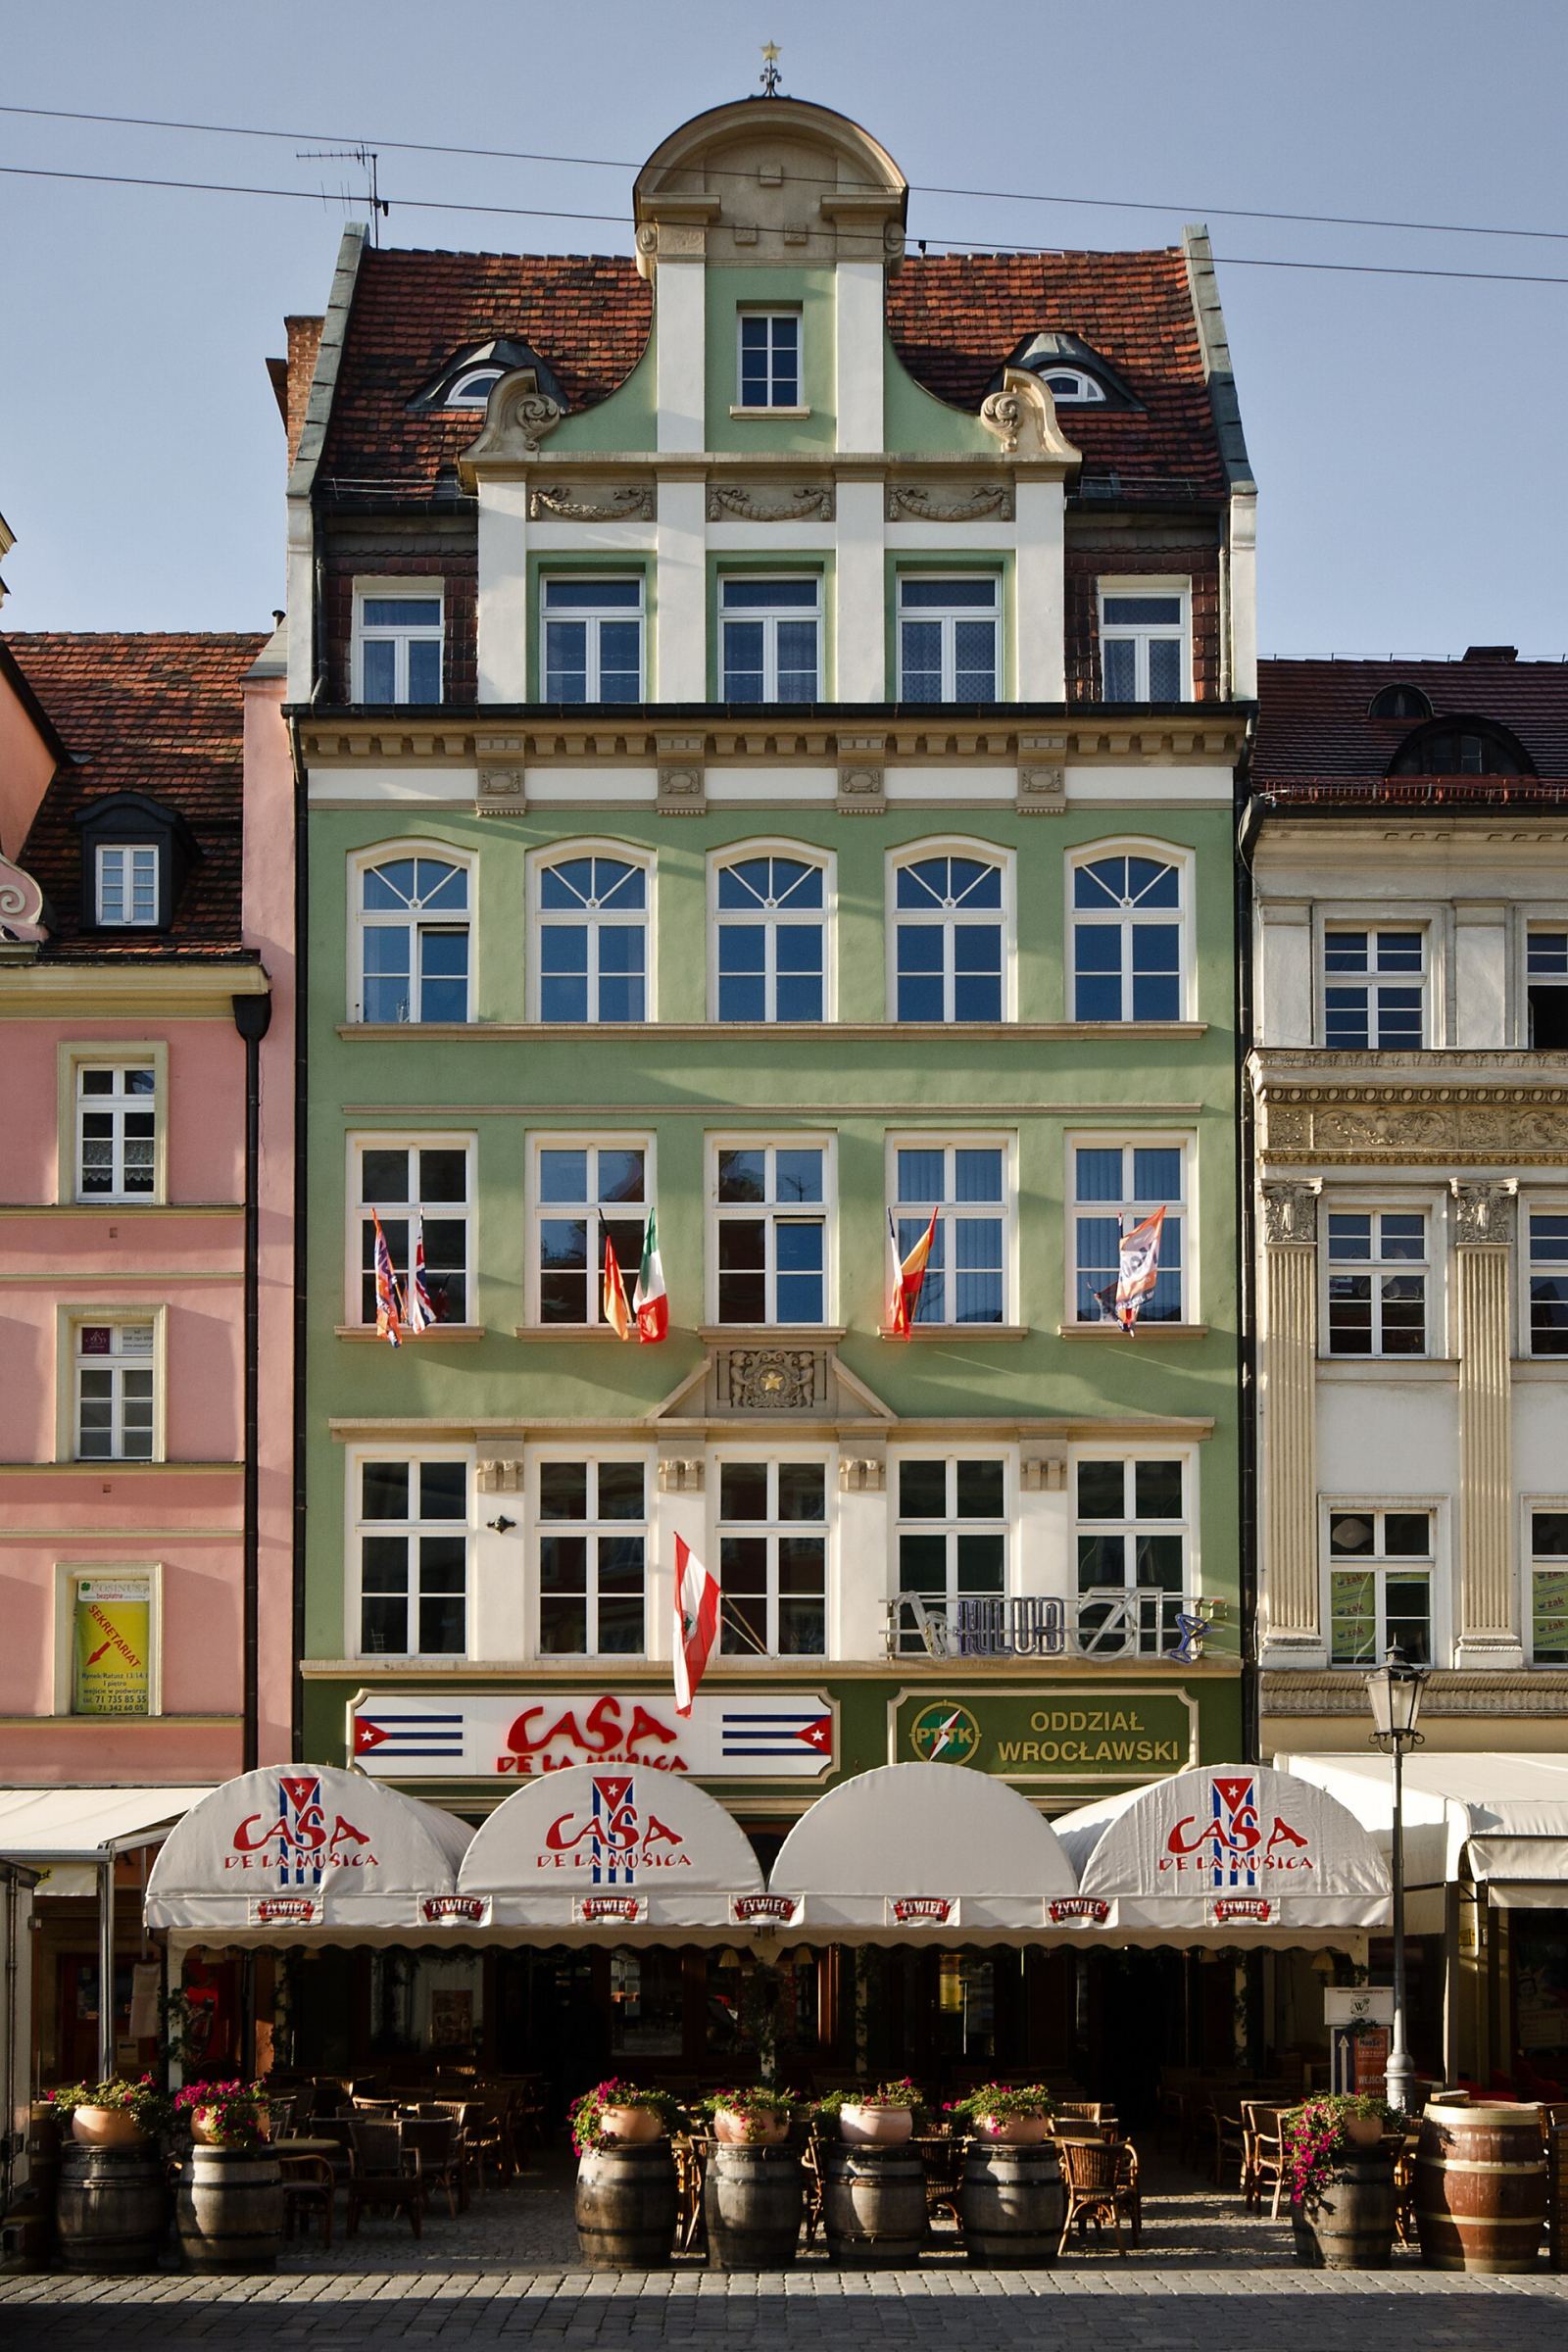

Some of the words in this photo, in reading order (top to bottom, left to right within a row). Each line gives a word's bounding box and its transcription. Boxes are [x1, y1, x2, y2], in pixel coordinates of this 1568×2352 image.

[1547, 1596, 1565, 1608] żak
[957, 1597, 1064, 1656] KLUB
[1548, 1620, 1565, 1631] żak
[88, 1604, 141, 1667] SEKRETARIAT
[507, 1695, 677, 1754] CASA
[1030, 1711, 1145, 1732] ODDZIAŁ
[916, 1728, 974, 1744] PTTK
[998, 1741, 1179, 1762] WROCŁAWSKI
[497, 1755, 534, 1773] DE
[542, 1755, 575, 1772] LA
[233, 1805, 370, 1853] CASA
[546, 1804, 683, 1852] CASA
[1167, 1805, 1308, 1854] CASA
[224, 1854, 254, 1869] DE
[262, 1854, 289, 1868] LA
[296, 1852, 379, 1869] MUSICA
[537, 1853, 566, 1868] DE
[574, 1853, 602, 1868] LA
[609, 1852, 692, 1869] MUSICA
[1159, 1856, 1189, 1871] DE
[1197, 1856, 1224, 1870] LA
[1231, 1854, 1314, 1871] MUSICA
[266, 1898, 308, 1916] ŻYWIEC
[430, 1897, 476, 1913] ŻYWIEC
[590, 1898, 632, 1914] ŻYWIEC
[743, 1897, 787, 1913] ŻYWIEC
[902, 1899, 944, 1914] ŻYWIEC
[1056, 1898, 1102, 1915] ŻYWIEC
[1222, 1900, 1264, 1915] ŻYWIEC
[1354, 2002, 1365, 2012] W
